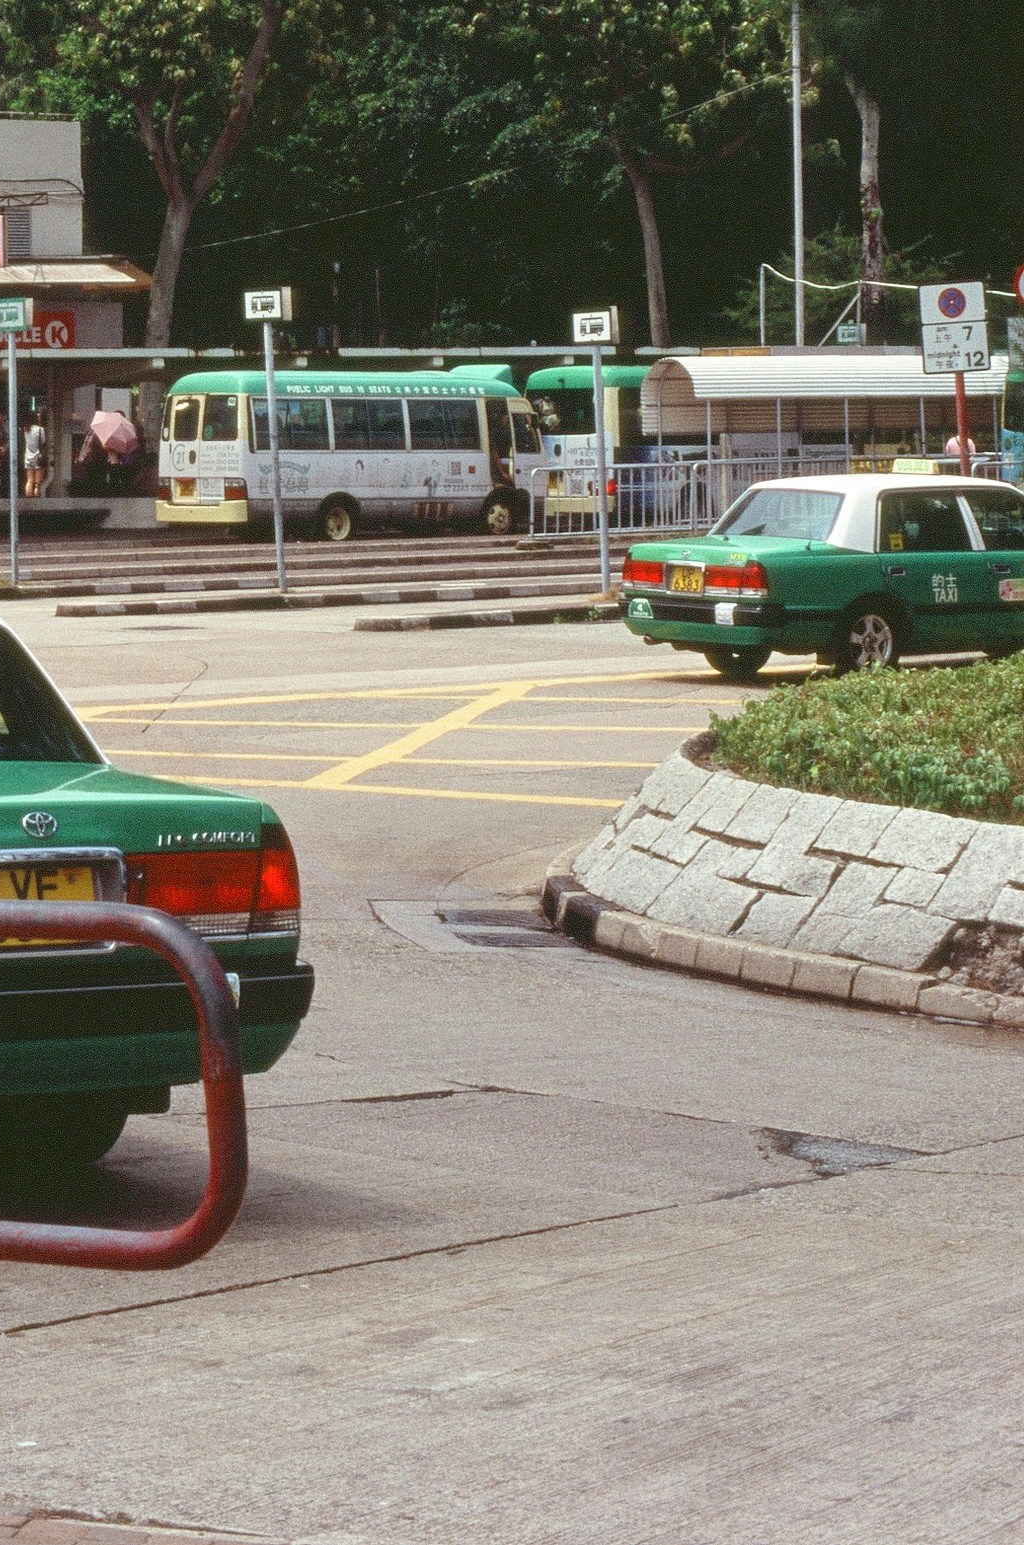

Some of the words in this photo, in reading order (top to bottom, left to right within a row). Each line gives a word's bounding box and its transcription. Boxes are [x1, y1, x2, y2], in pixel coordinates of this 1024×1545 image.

[935, 334, 952, 343] 上午
[962, 325, 973, 341] 7
[928, 350, 961, 359] midnight
[965, 350, 985, 368] 12
[286, 385, 311, 393] PUBLIC
[315, 385, 334, 393] LIGHT
[338, 385, 353, 393] BUS
[369, 385, 391, 394] SEATS
[931, 573, 957, 587] 的士
[933, 588, 959, 603] TAXI
[637, 603, 644, 611] 4
